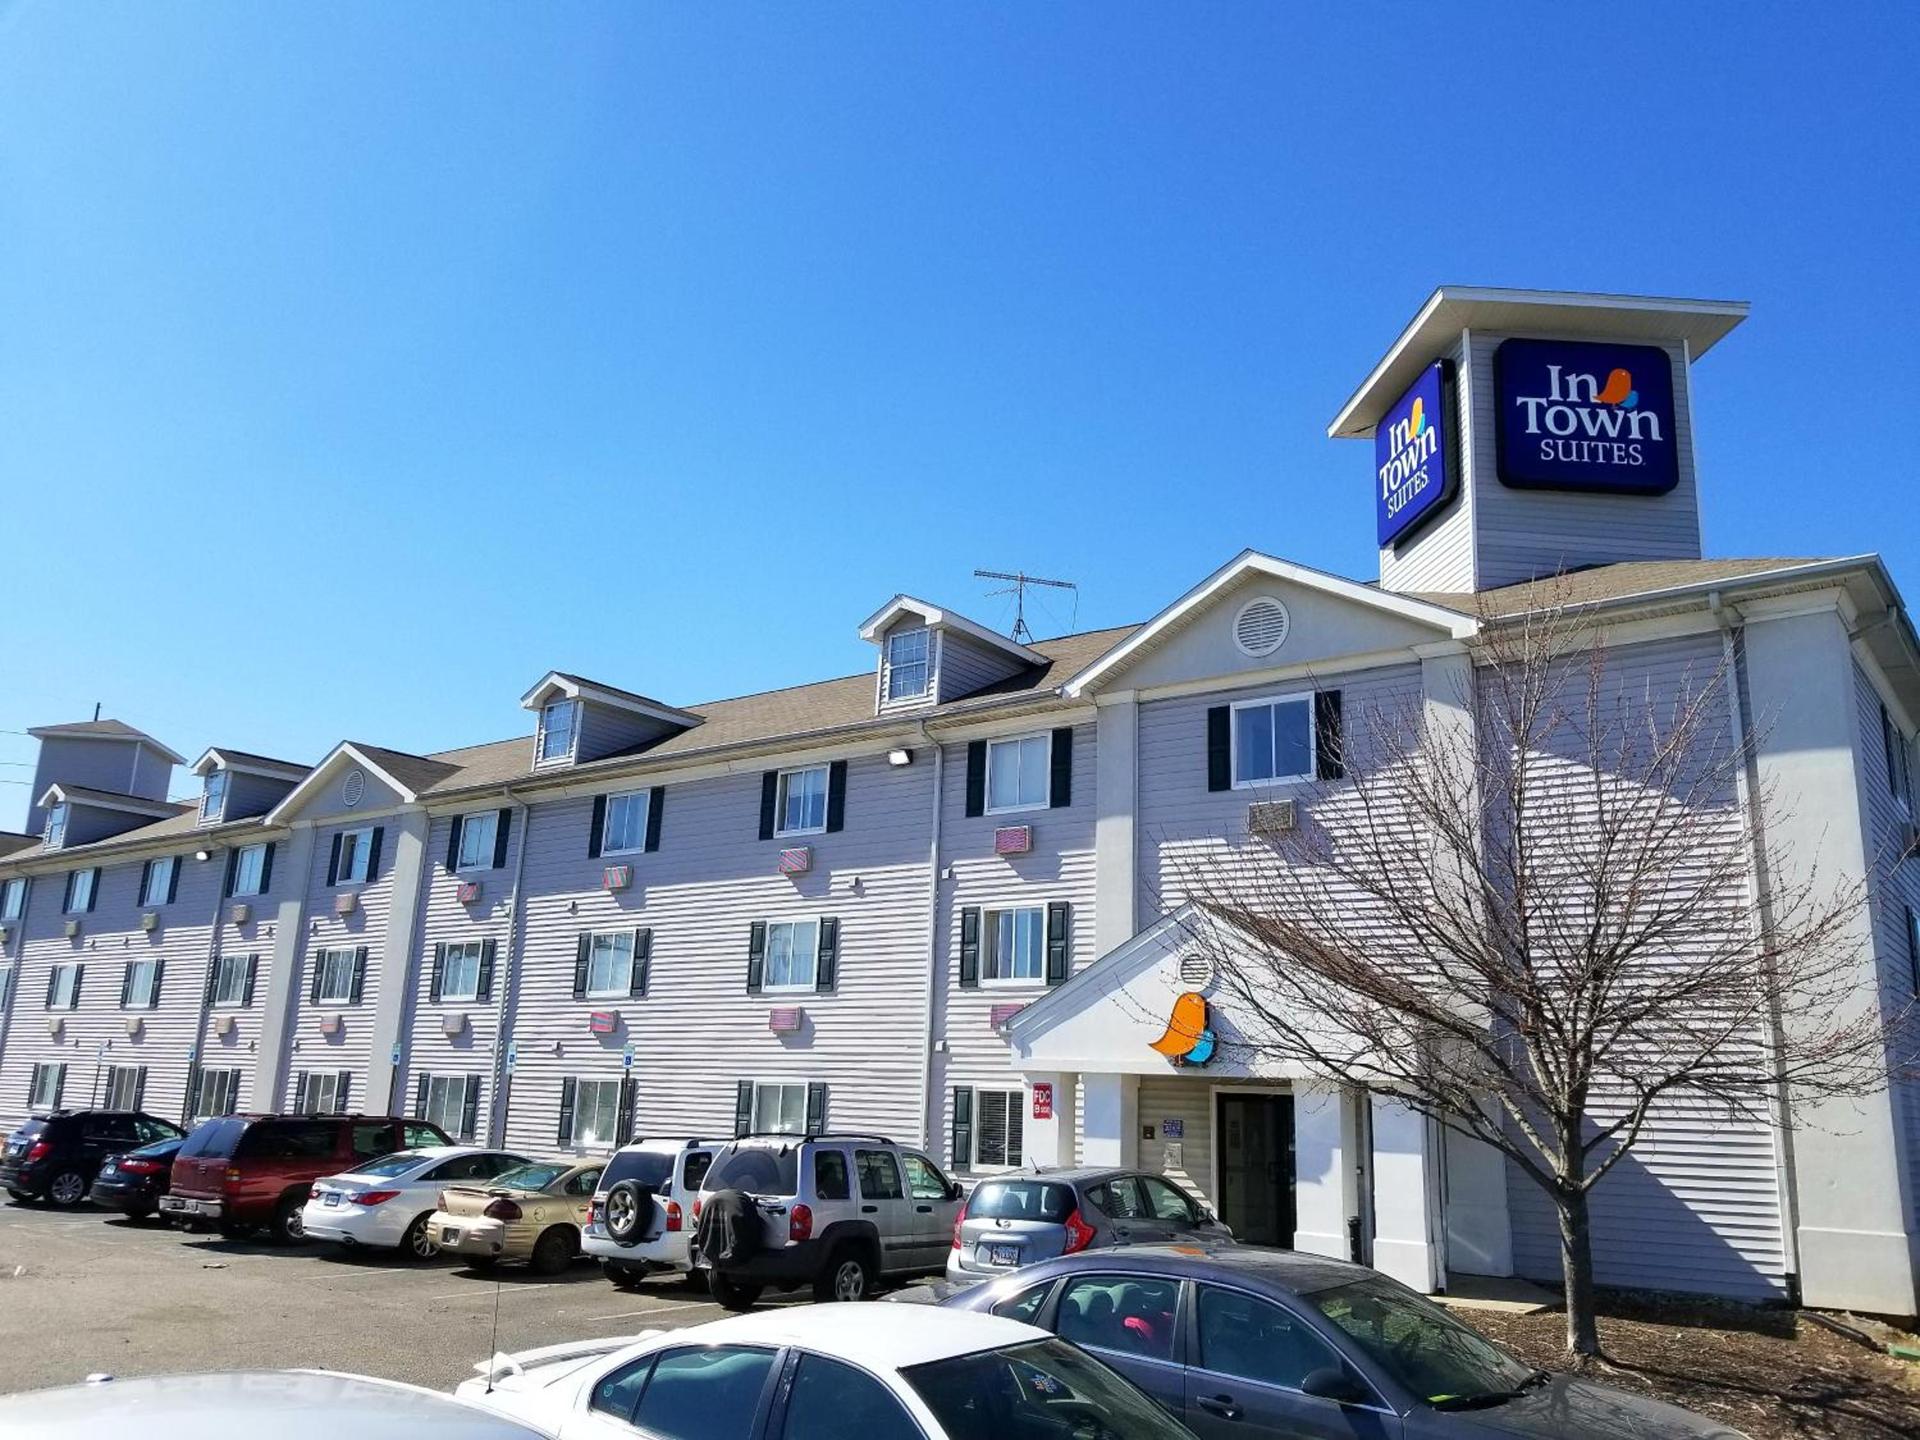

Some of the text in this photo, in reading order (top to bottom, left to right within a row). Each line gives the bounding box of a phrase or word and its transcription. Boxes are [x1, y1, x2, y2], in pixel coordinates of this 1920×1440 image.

[1547, 365, 1601, 403] In
[1389, 418, 1412, 460] In
[1516, 397, 1663, 440] Town
[1380, 426, 1437, 500] Town
[1541, 439, 1643, 465] SUITES
[1388, 465, 1428, 518] SUITES
